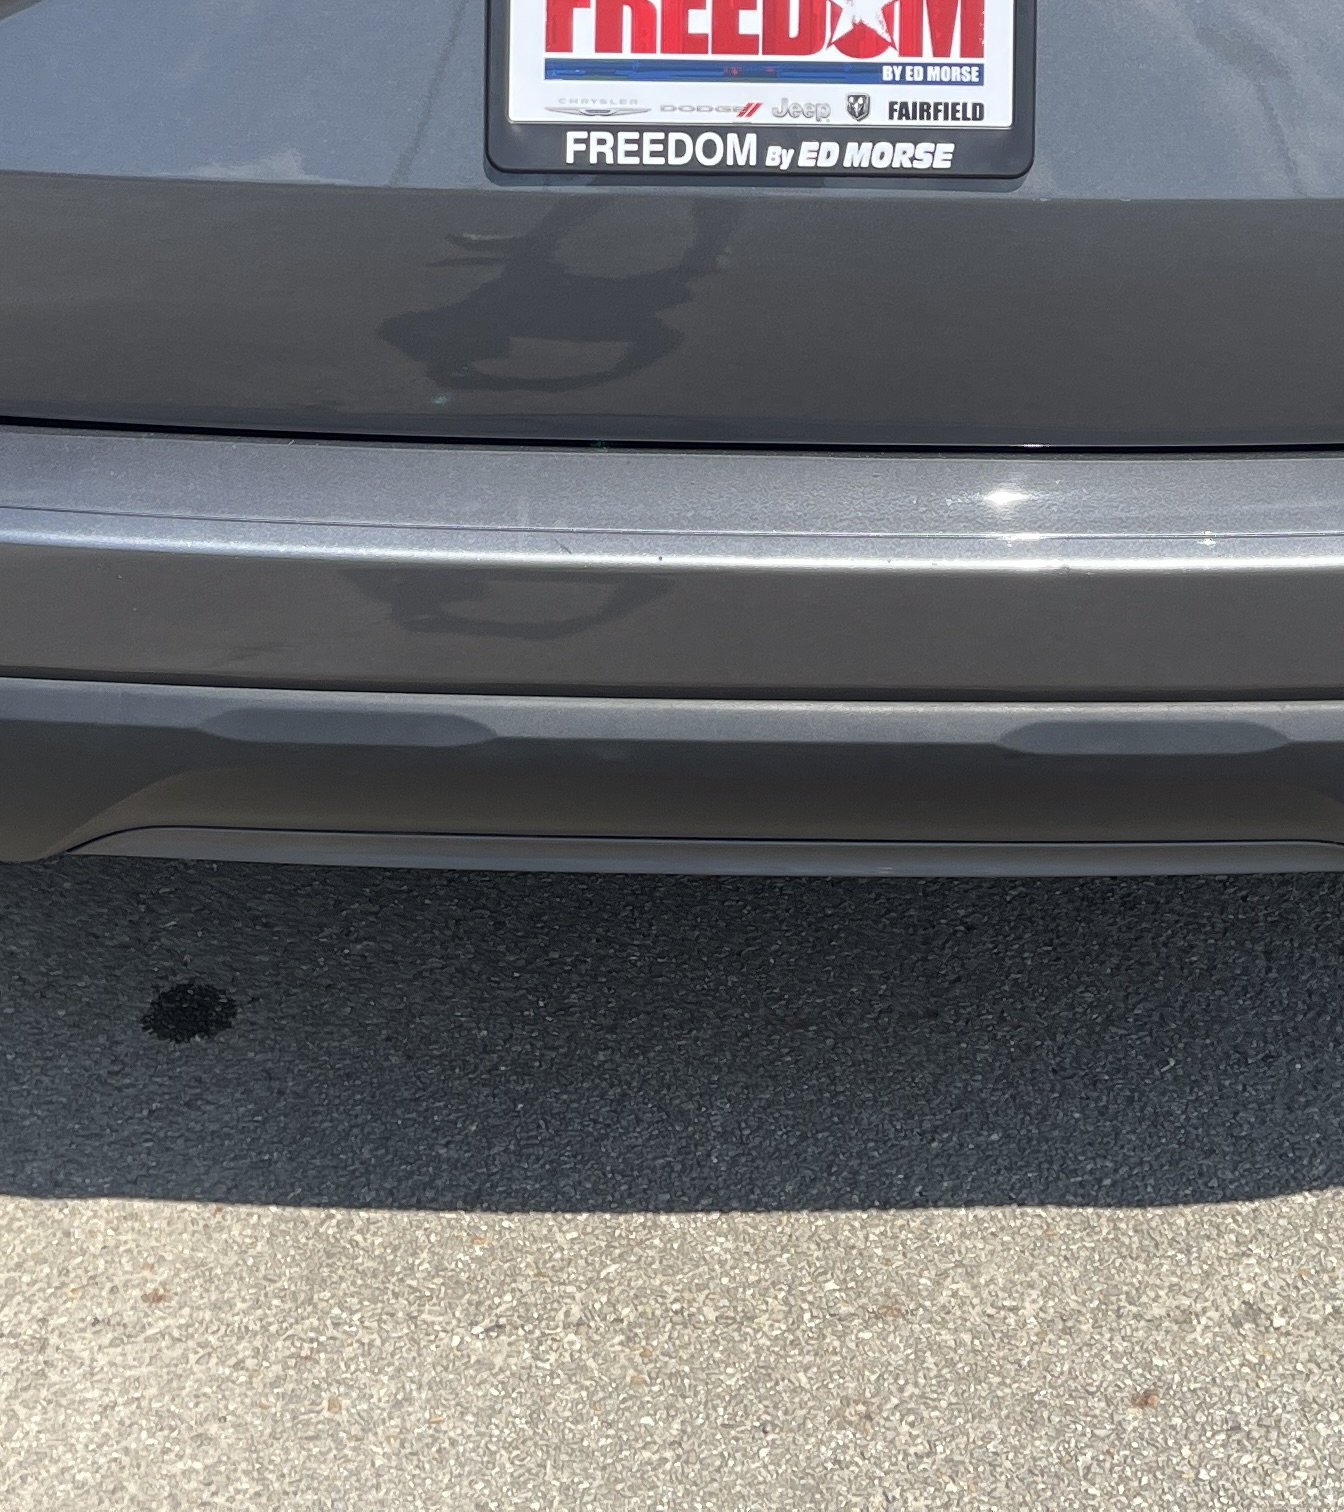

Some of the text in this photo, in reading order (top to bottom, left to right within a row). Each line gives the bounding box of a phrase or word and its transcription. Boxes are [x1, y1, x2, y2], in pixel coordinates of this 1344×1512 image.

[882, 65, 980, 83] BY ED MORSE
[659, 104, 749, 114] DODGE
[771, 98, 832, 122] Jeep
[887, 100, 985, 122] FAIRFIELD
[565, 131, 955, 169] FREEDOM By ED MORSE
